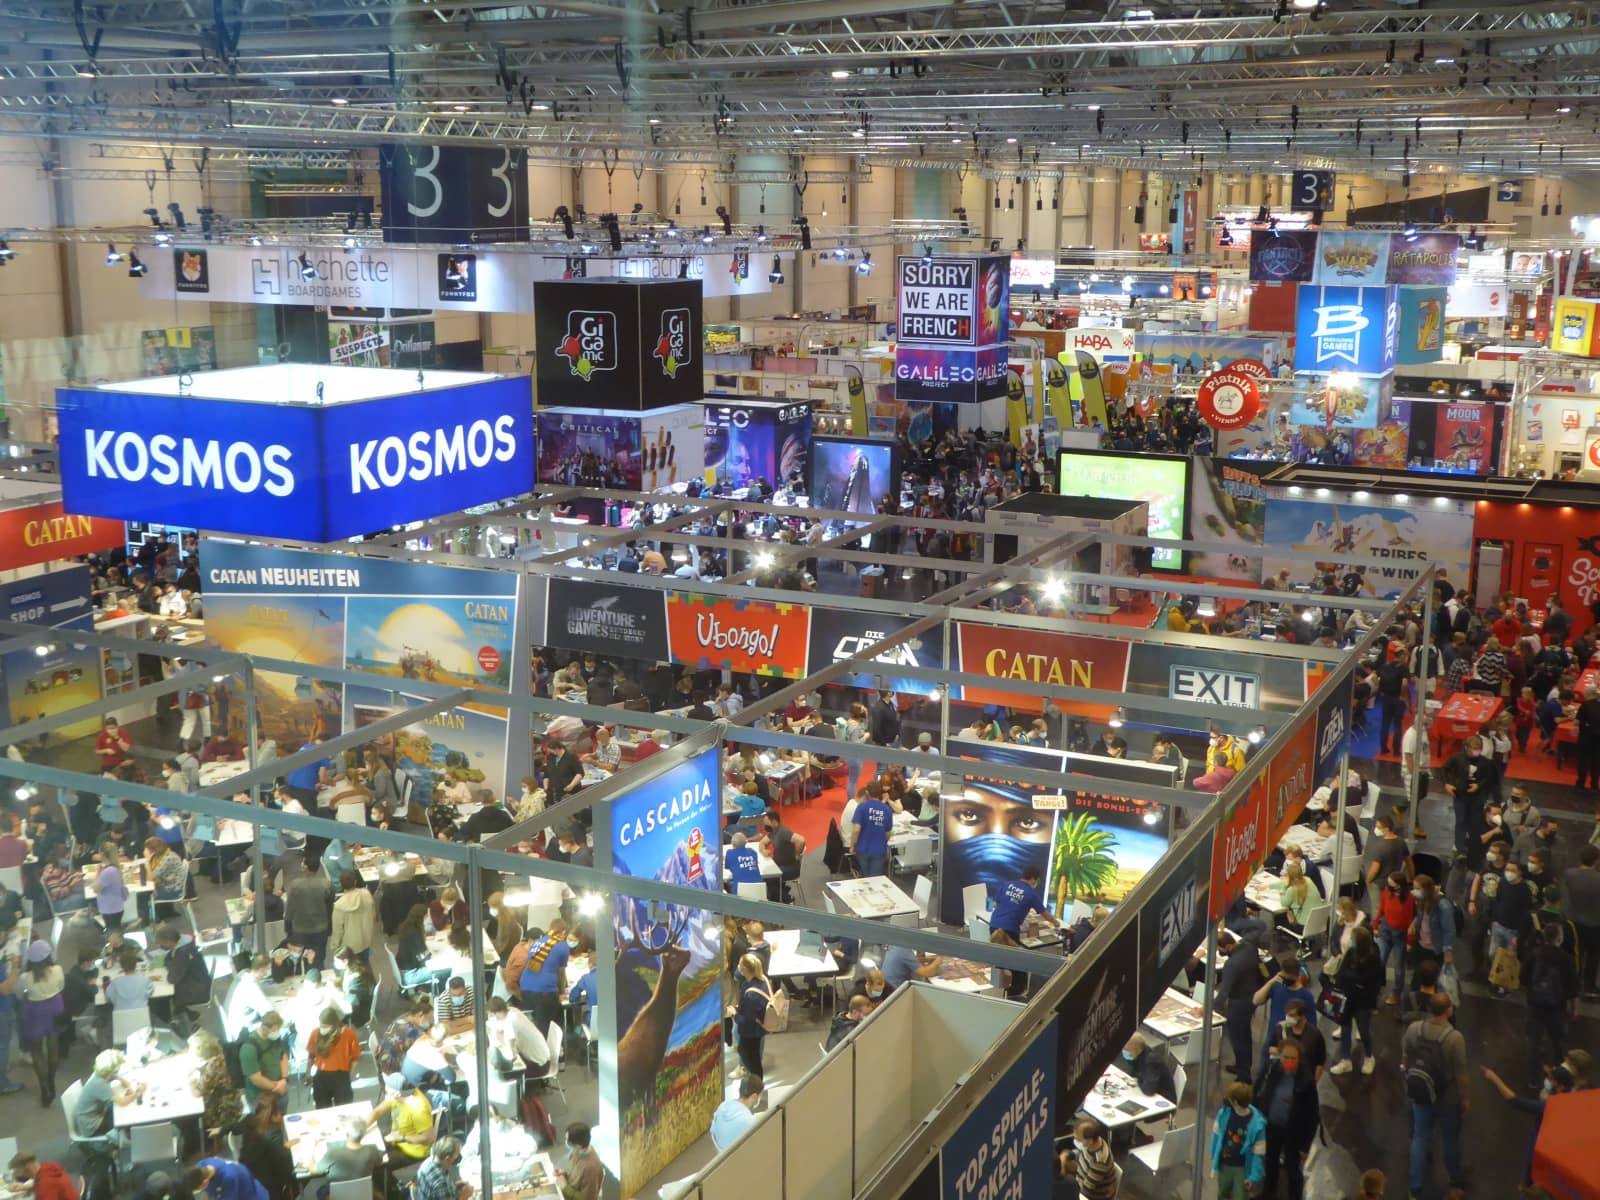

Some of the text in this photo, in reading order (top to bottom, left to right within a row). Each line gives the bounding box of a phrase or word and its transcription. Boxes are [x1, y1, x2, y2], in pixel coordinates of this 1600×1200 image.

[407, 145, 443, 217] 3
[487, 148, 512, 217] 3
[1301, 173, 1317, 203] 3
[287, 250, 389, 282] hchette
[1393, 251, 1455, 267] RATAPOLIS
[904, 264, 970, 286] SORRY
[287, 285, 361, 298] BOARDGAMES
[905, 291, 968, 311] WE ARE
[903, 316, 970, 337] FRENCH
[335, 335, 384, 358] SUSPECTS
[1074, 334, 1112, 351] HABA
[1322, 342, 1354, 351] GAMES
[1205, 373, 1252, 395] Piatnik
[1447, 407, 1481, 420] MOON
[558, 422, 619, 432] CRITICAL
[85, 428, 295, 497] KOSMOS
[351, 414, 517, 494] KOSMOS
[24, 514, 93, 547] CATAN
[210, 567, 361, 588] CATAN NEUHEITEN
[10, 606, 45, 623] SHOP
[464, 601, 509, 623] CATAN
[567, 607, 636, 628] ADVENTURE
[567, 620, 609, 638] GAMES
[697, 612, 779, 658] Ubongo!
[865, 630, 886, 639] DIE
[985, 648, 1094, 689] CATAN
[1173, 669, 1255, 706] EXIT
[620, 778, 712, 846] CASCADIA
[1075, 798, 1091, 807] DIE
[1096, 801, 1152, 816] BONUS-BO
[1161, 880, 1194, 945] EXIT
[1021, 1096, 1049, 1157] ALS
[956, 1143, 989, 1200] TOP
